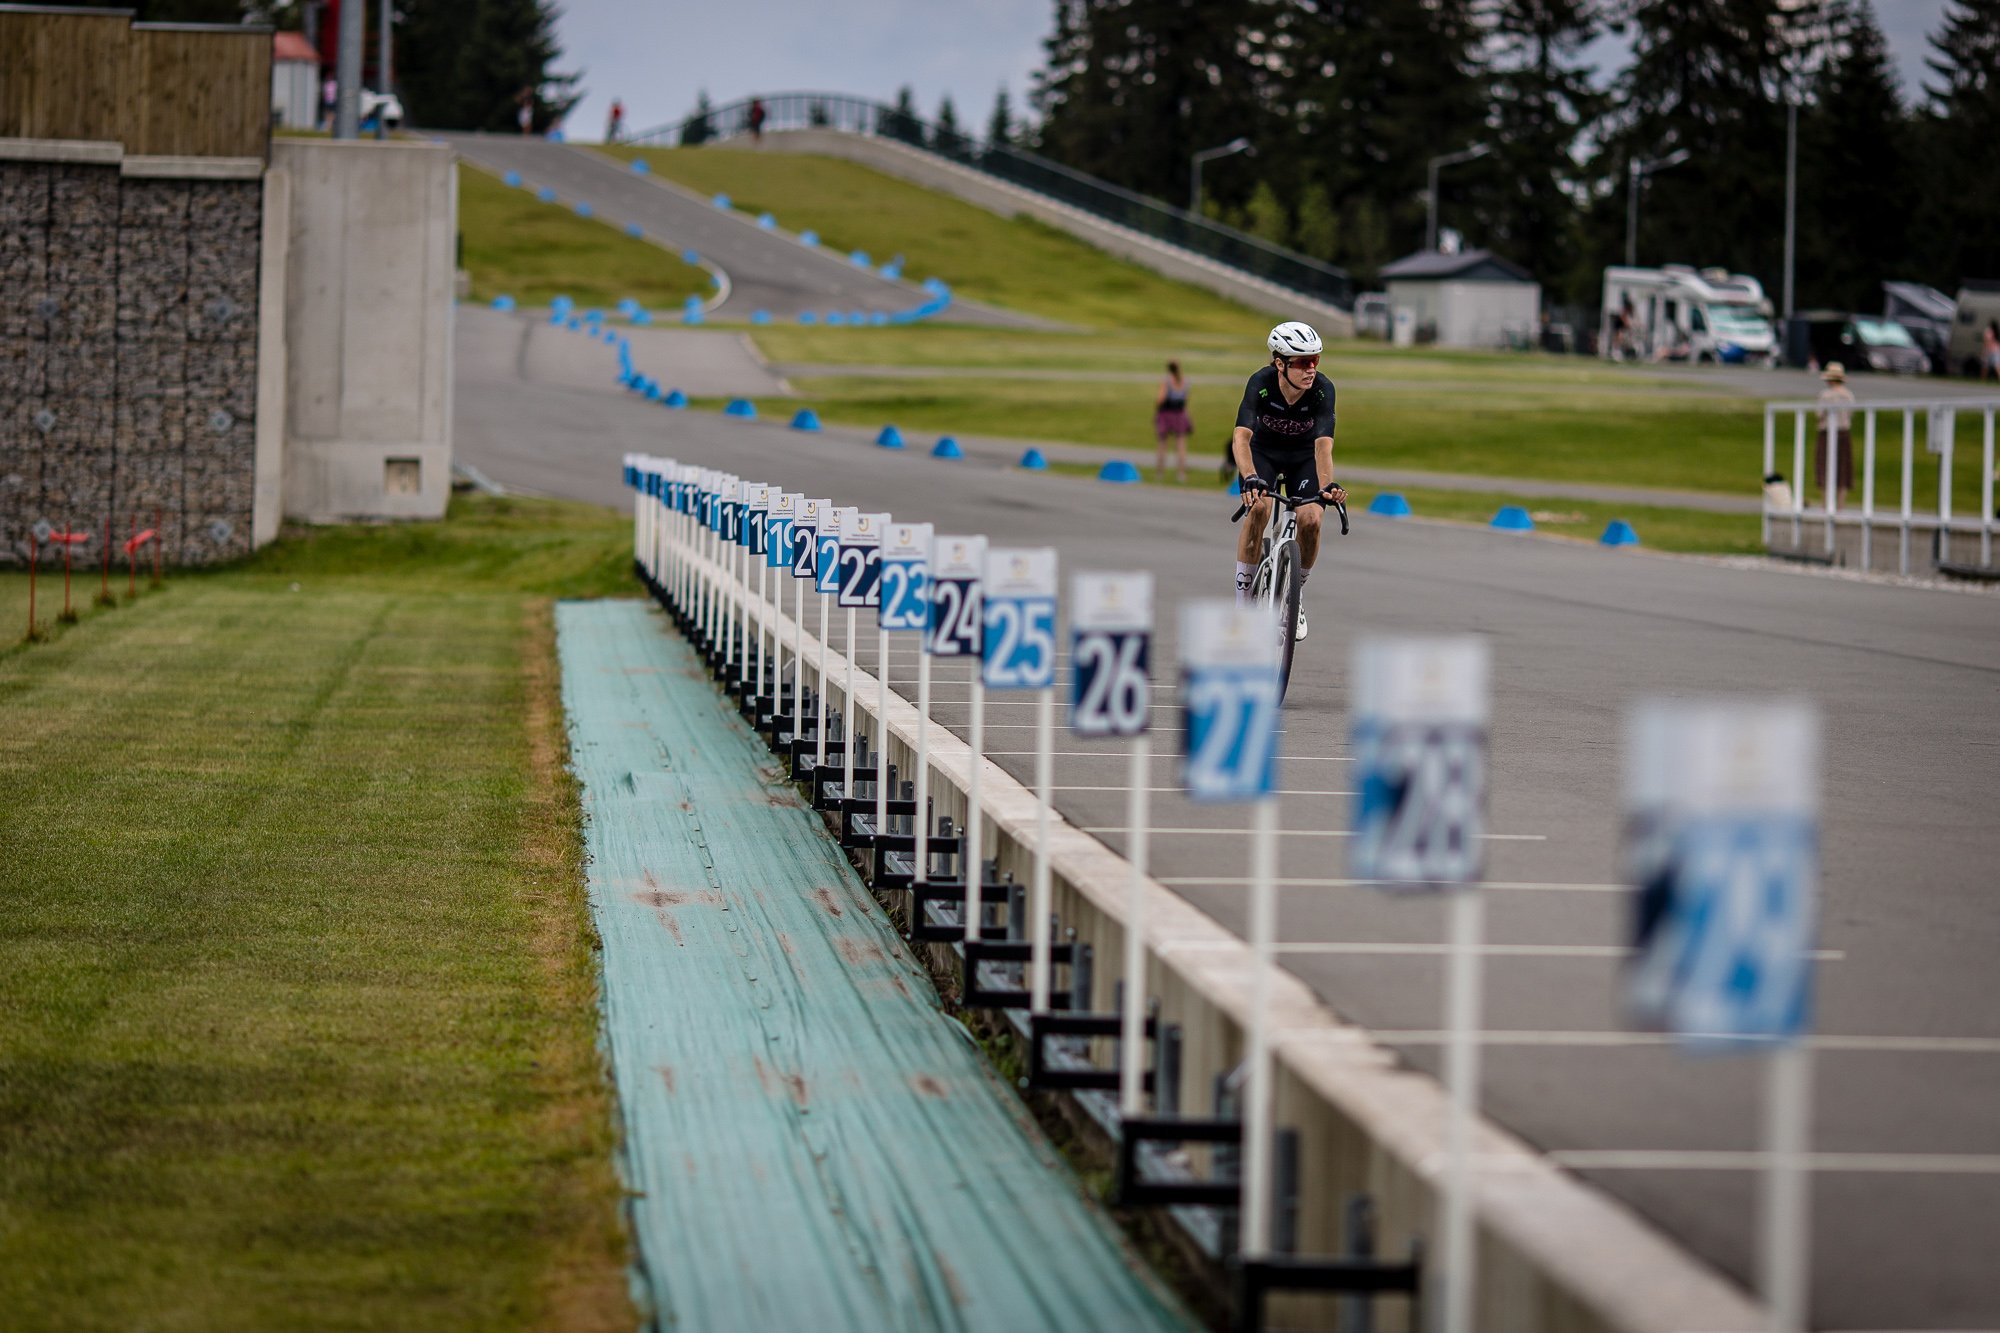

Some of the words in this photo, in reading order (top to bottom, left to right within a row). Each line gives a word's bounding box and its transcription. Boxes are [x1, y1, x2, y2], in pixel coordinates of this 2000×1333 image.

[723, 503, 737, 540] 1
[820, 539, 840, 591] 2
[839, 547, 881, 606] 22
[881, 562, 928, 628] 23
[935, 581, 983, 655] 24
[983, 600, 1055, 684] 25
[1075, 636, 1150, 733] 26
[1188, 680, 1278, 792] 27
[1378, 738, 1486, 882] 28
